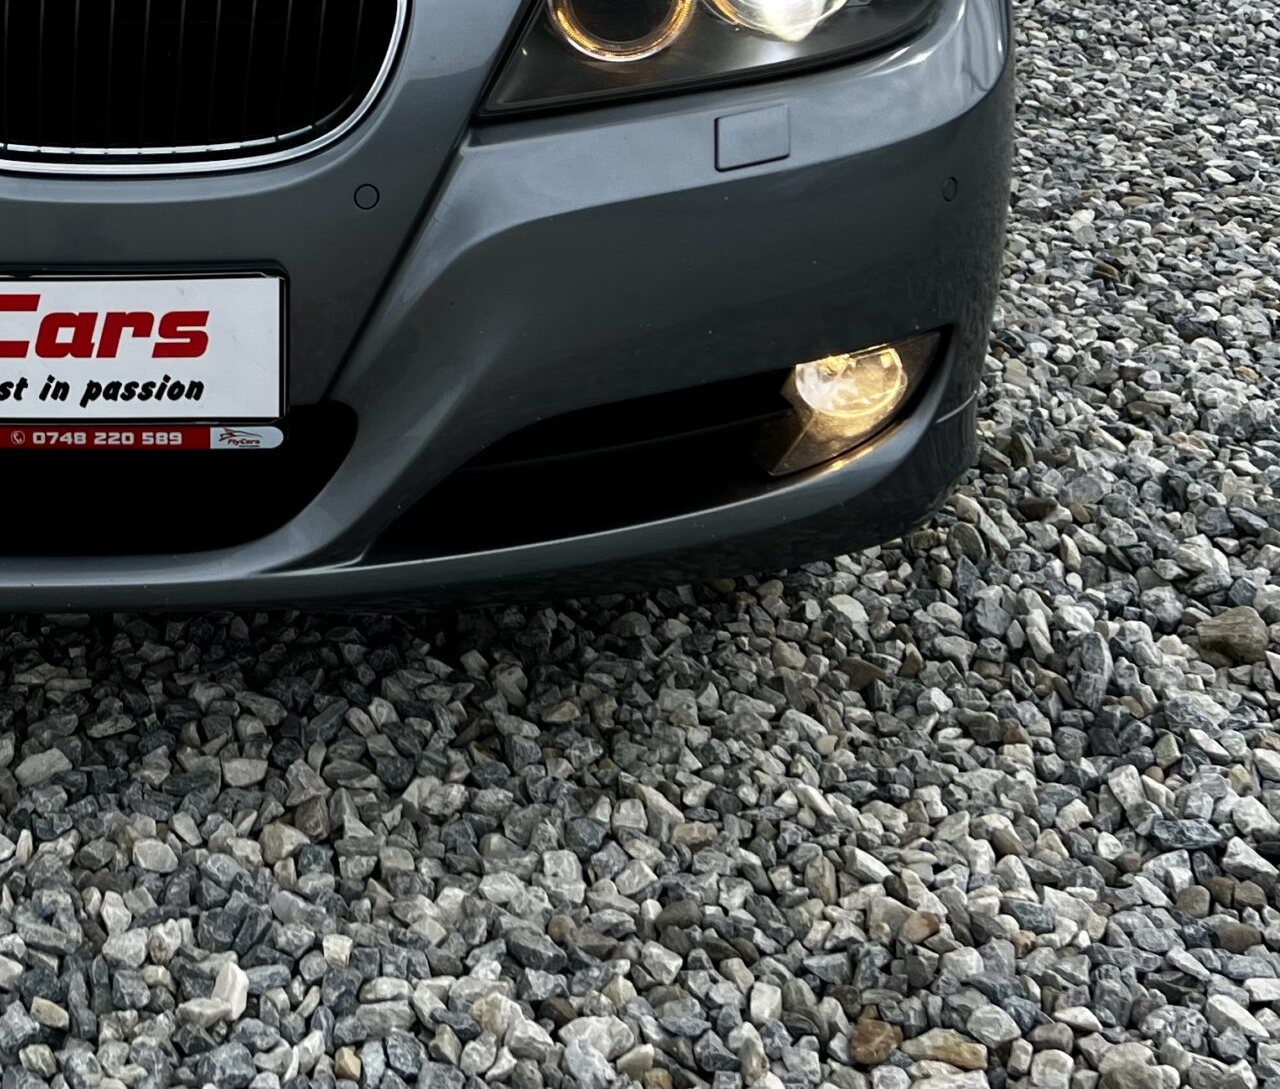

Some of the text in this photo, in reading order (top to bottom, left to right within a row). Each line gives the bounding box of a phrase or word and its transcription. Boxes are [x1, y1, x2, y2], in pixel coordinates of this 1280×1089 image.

[38, 374, 70, 401] in
[79, 374, 205, 408] passion
[32, 432, 87, 445] 0748
[93, 432, 135, 445] 220
[141, 432, 182, 445] 589
